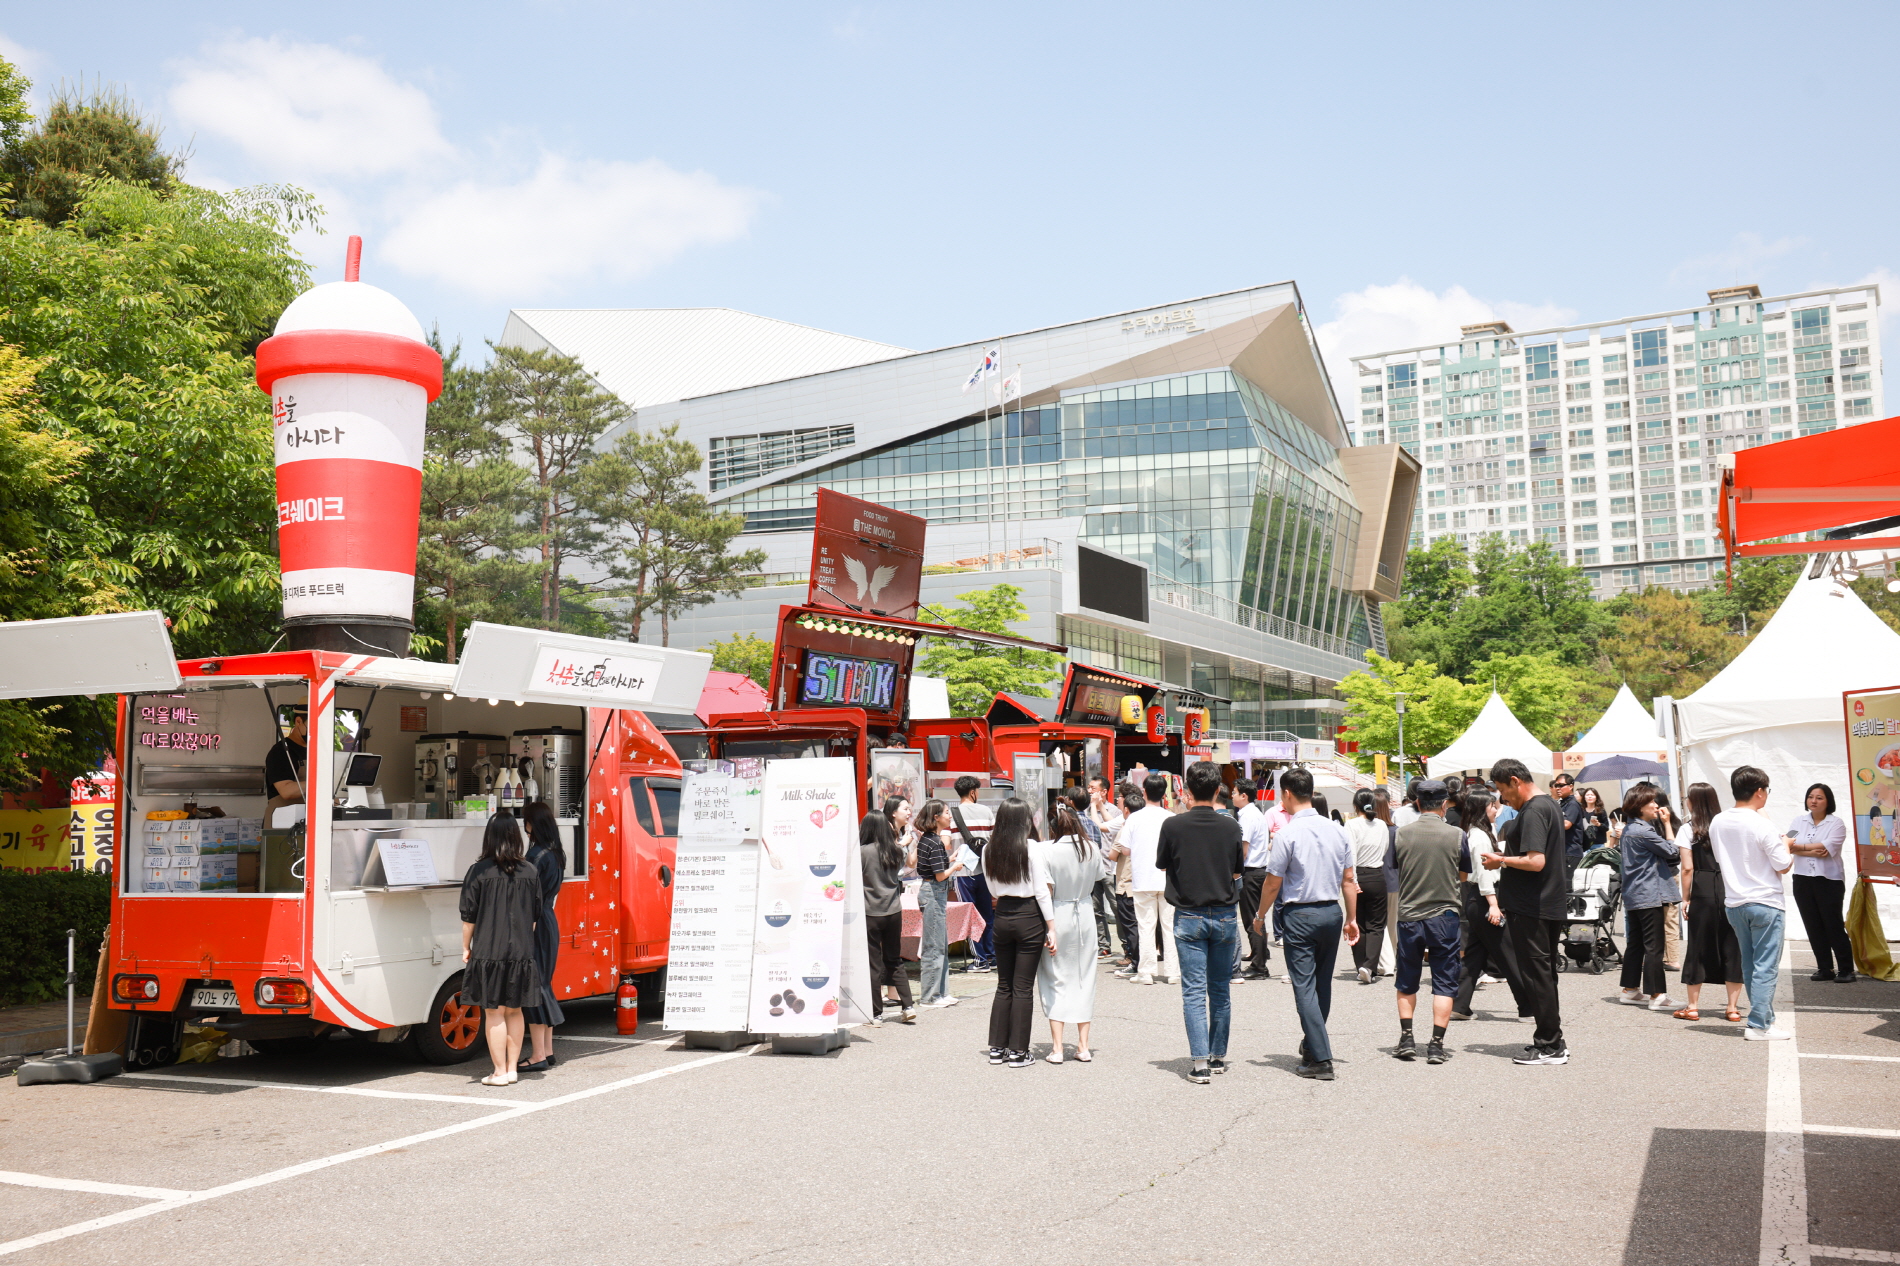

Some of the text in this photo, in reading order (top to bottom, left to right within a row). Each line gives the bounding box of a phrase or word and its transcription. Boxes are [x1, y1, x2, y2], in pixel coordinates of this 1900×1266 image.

[287, 426, 345, 448] 마시다
[863, 510, 889, 523] FOOD TRUCK
[860, 521, 896, 540] THE MONICA
[820, 556, 835, 565] UNITY
[820, 565, 835, 575] TREAT
[818, 575, 836, 584] COFFEE
[288, 586, 306, 599] 디저트
[308, 583, 345, 596] 푸드트럭
[611, 673, 645, 690] 마시다
[805, 656, 895, 705] STEAK
[1852, 717, 1885, 738] 떡볶이는
[781, 789, 836, 801] Milk Shake
[694, 797, 731, 808] 바로 만든
[197, 991, 217, 1005] 90노
